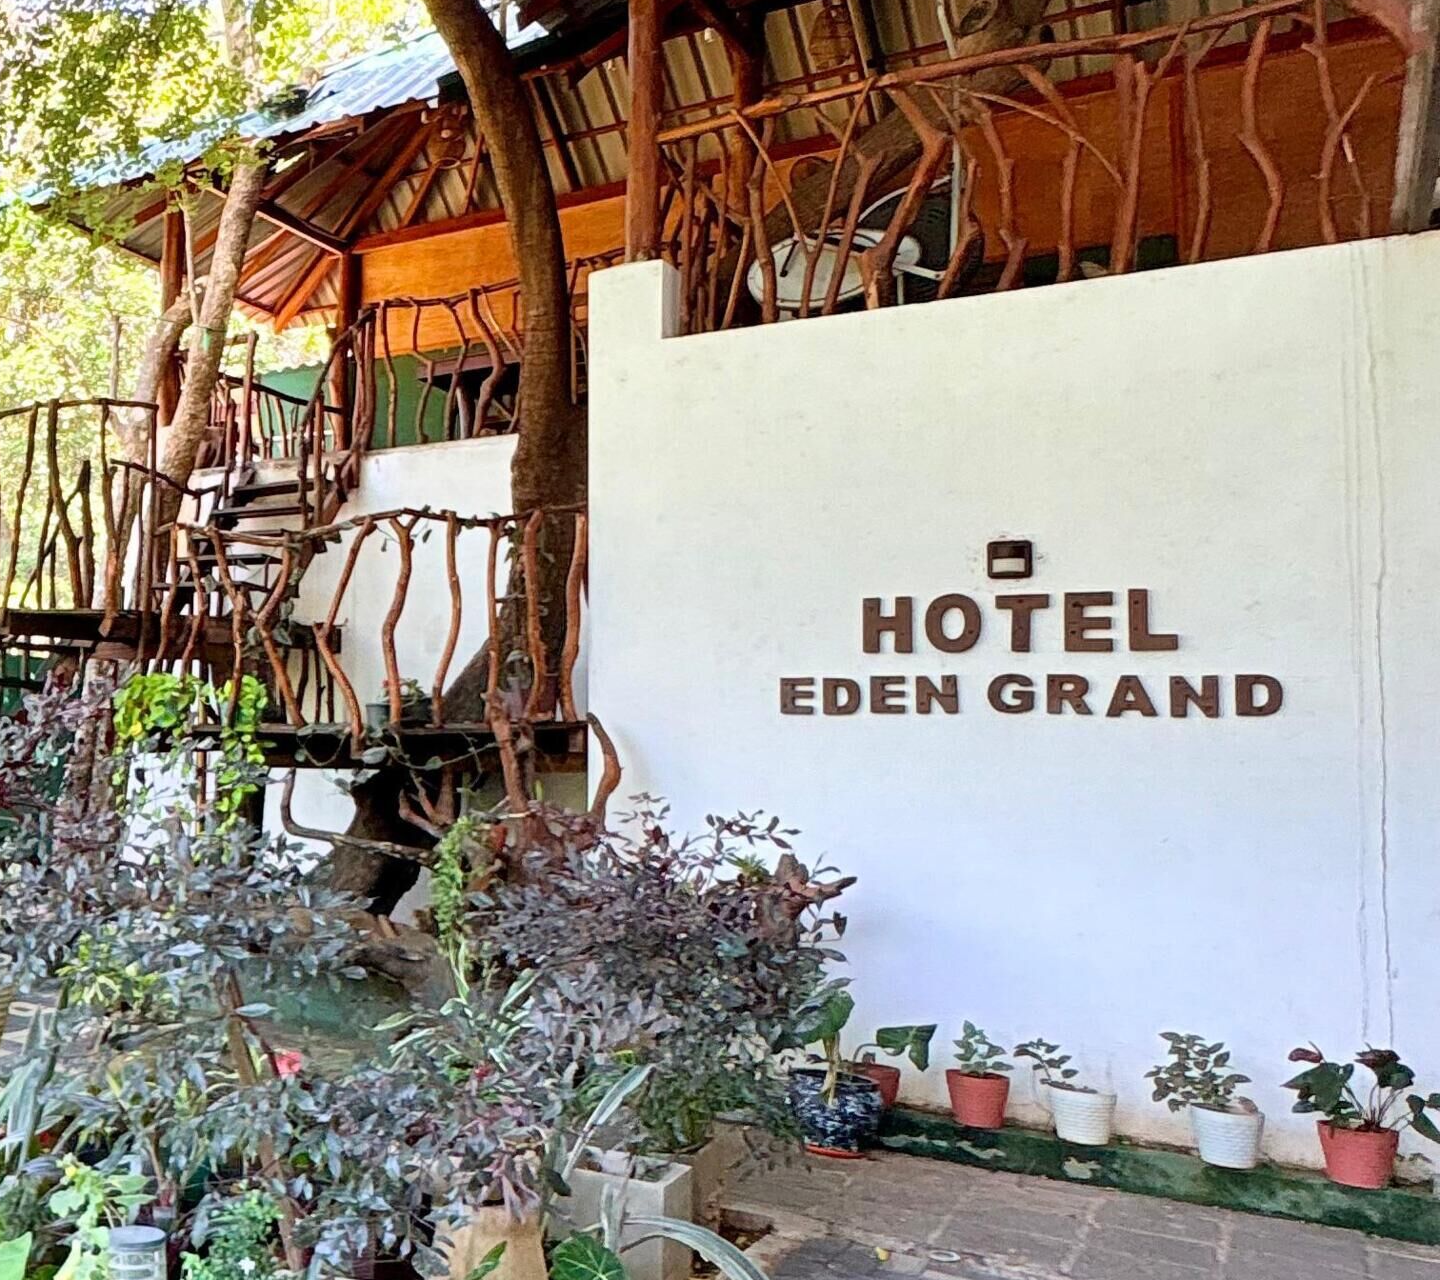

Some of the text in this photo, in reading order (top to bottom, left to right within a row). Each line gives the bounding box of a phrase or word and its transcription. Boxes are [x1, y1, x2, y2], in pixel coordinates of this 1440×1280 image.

[862, 588, 1179, 654] HOTEL
[779, 673, 1285, 719] EDEN GRAND
